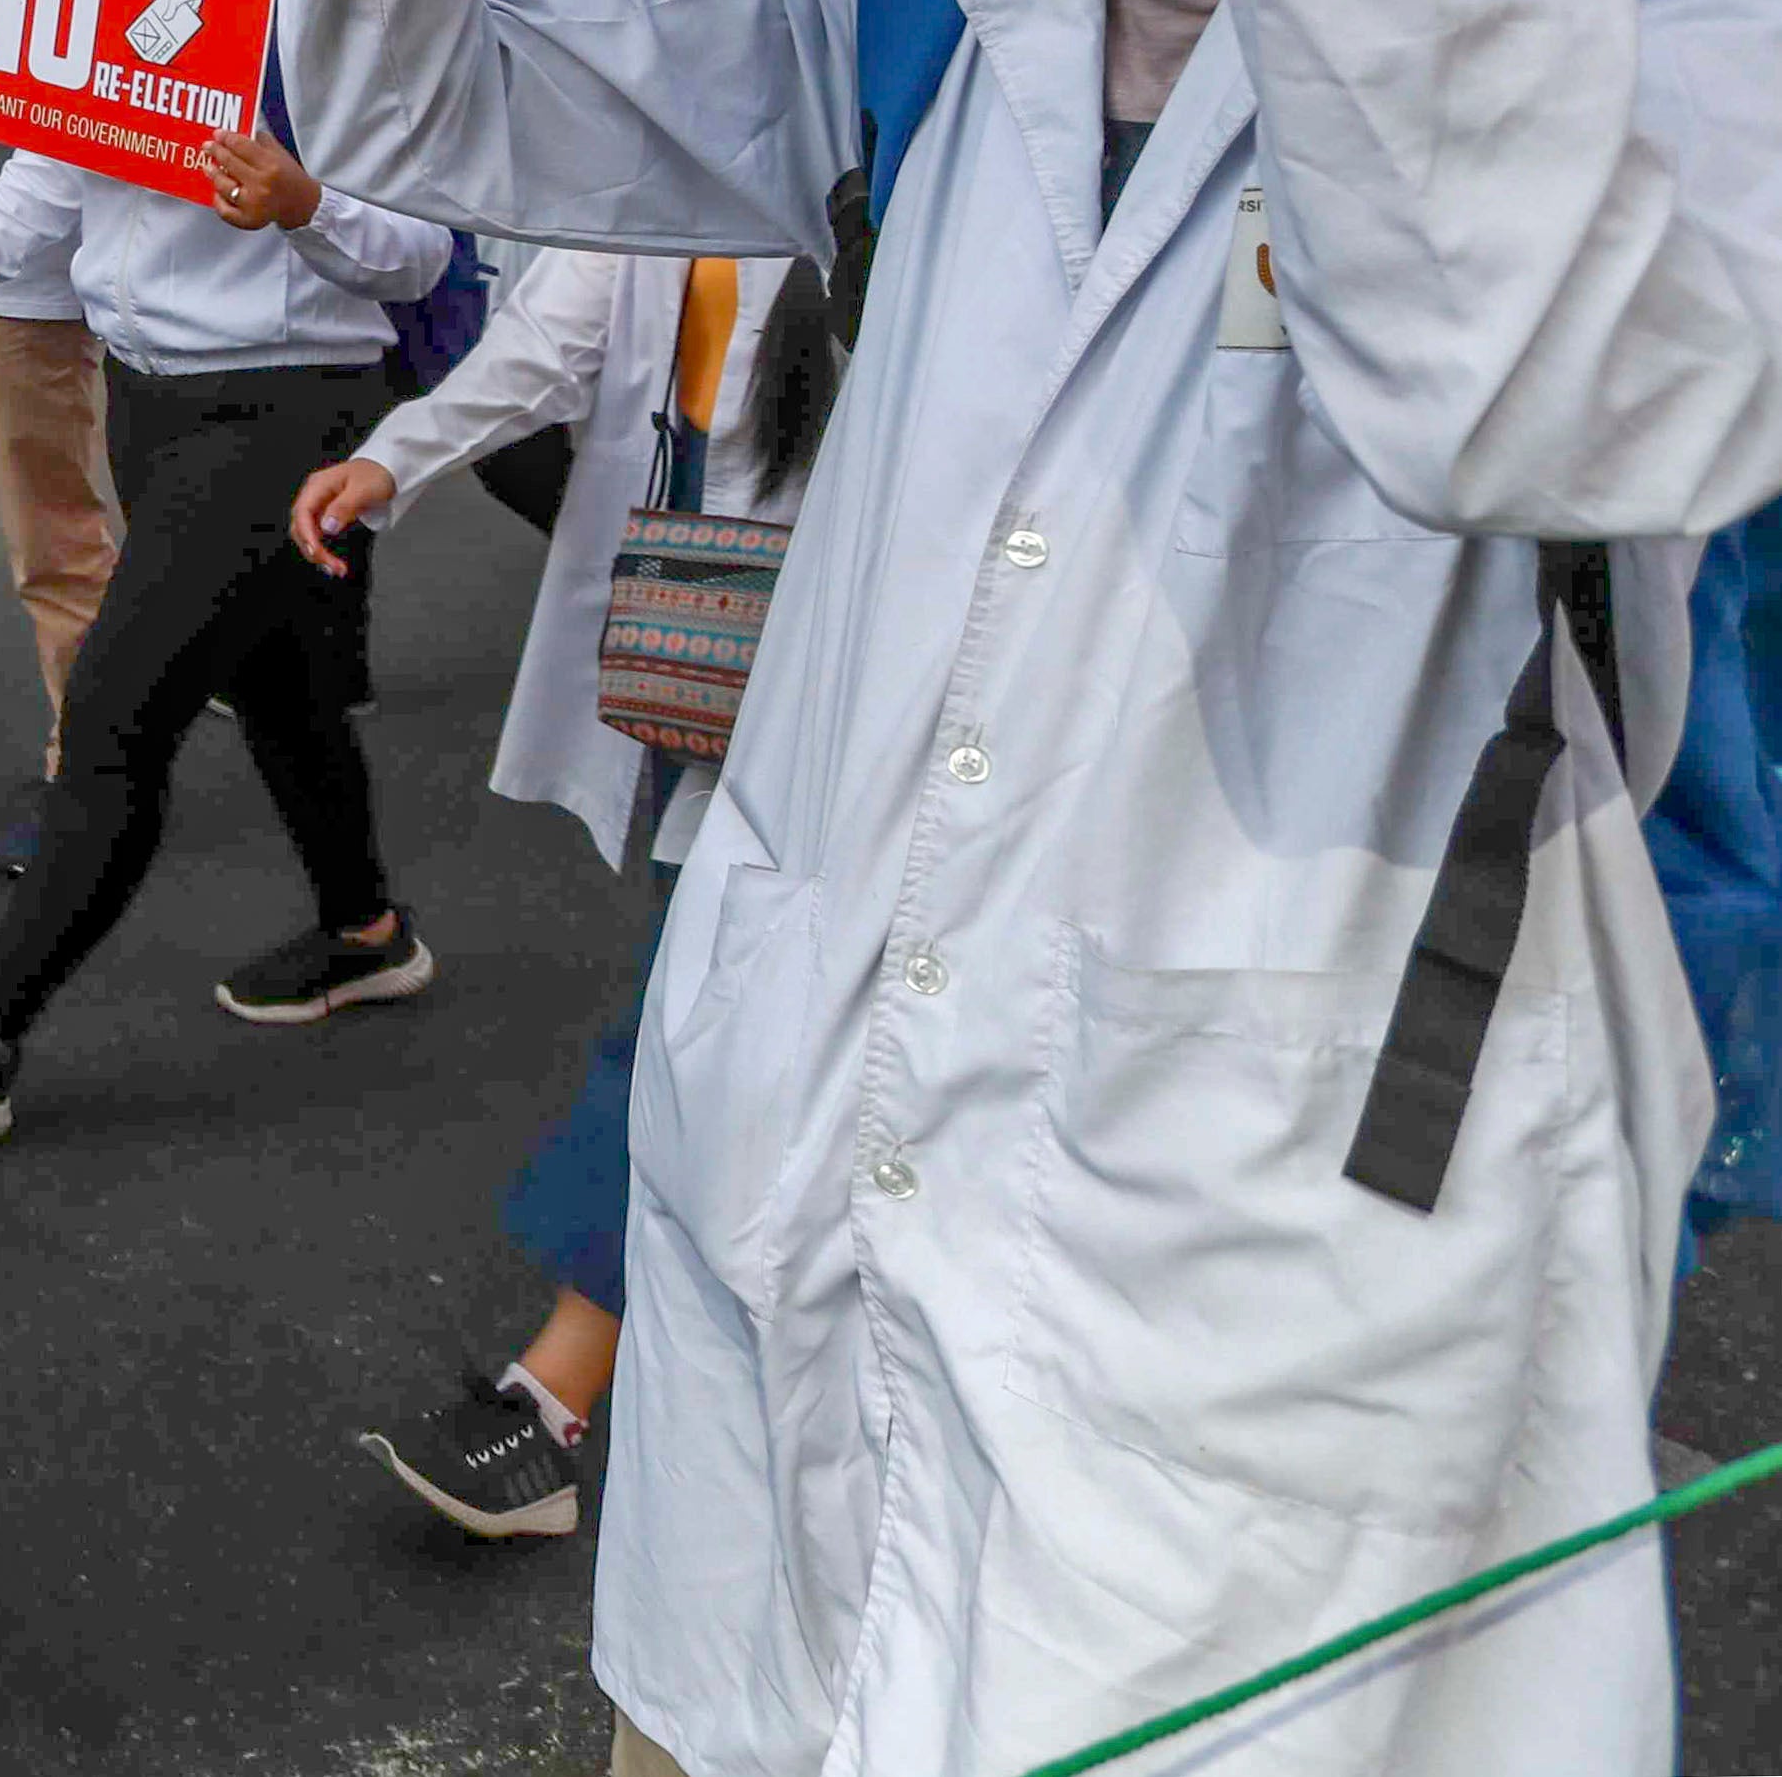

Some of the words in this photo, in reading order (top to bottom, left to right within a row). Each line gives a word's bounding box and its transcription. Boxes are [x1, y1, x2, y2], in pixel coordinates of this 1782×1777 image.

[93, 60, 242, 132] RE-ELECTION
[30, 103, 62, 132] OUR
[66, 113, 179, 164] GOVERNMENT
